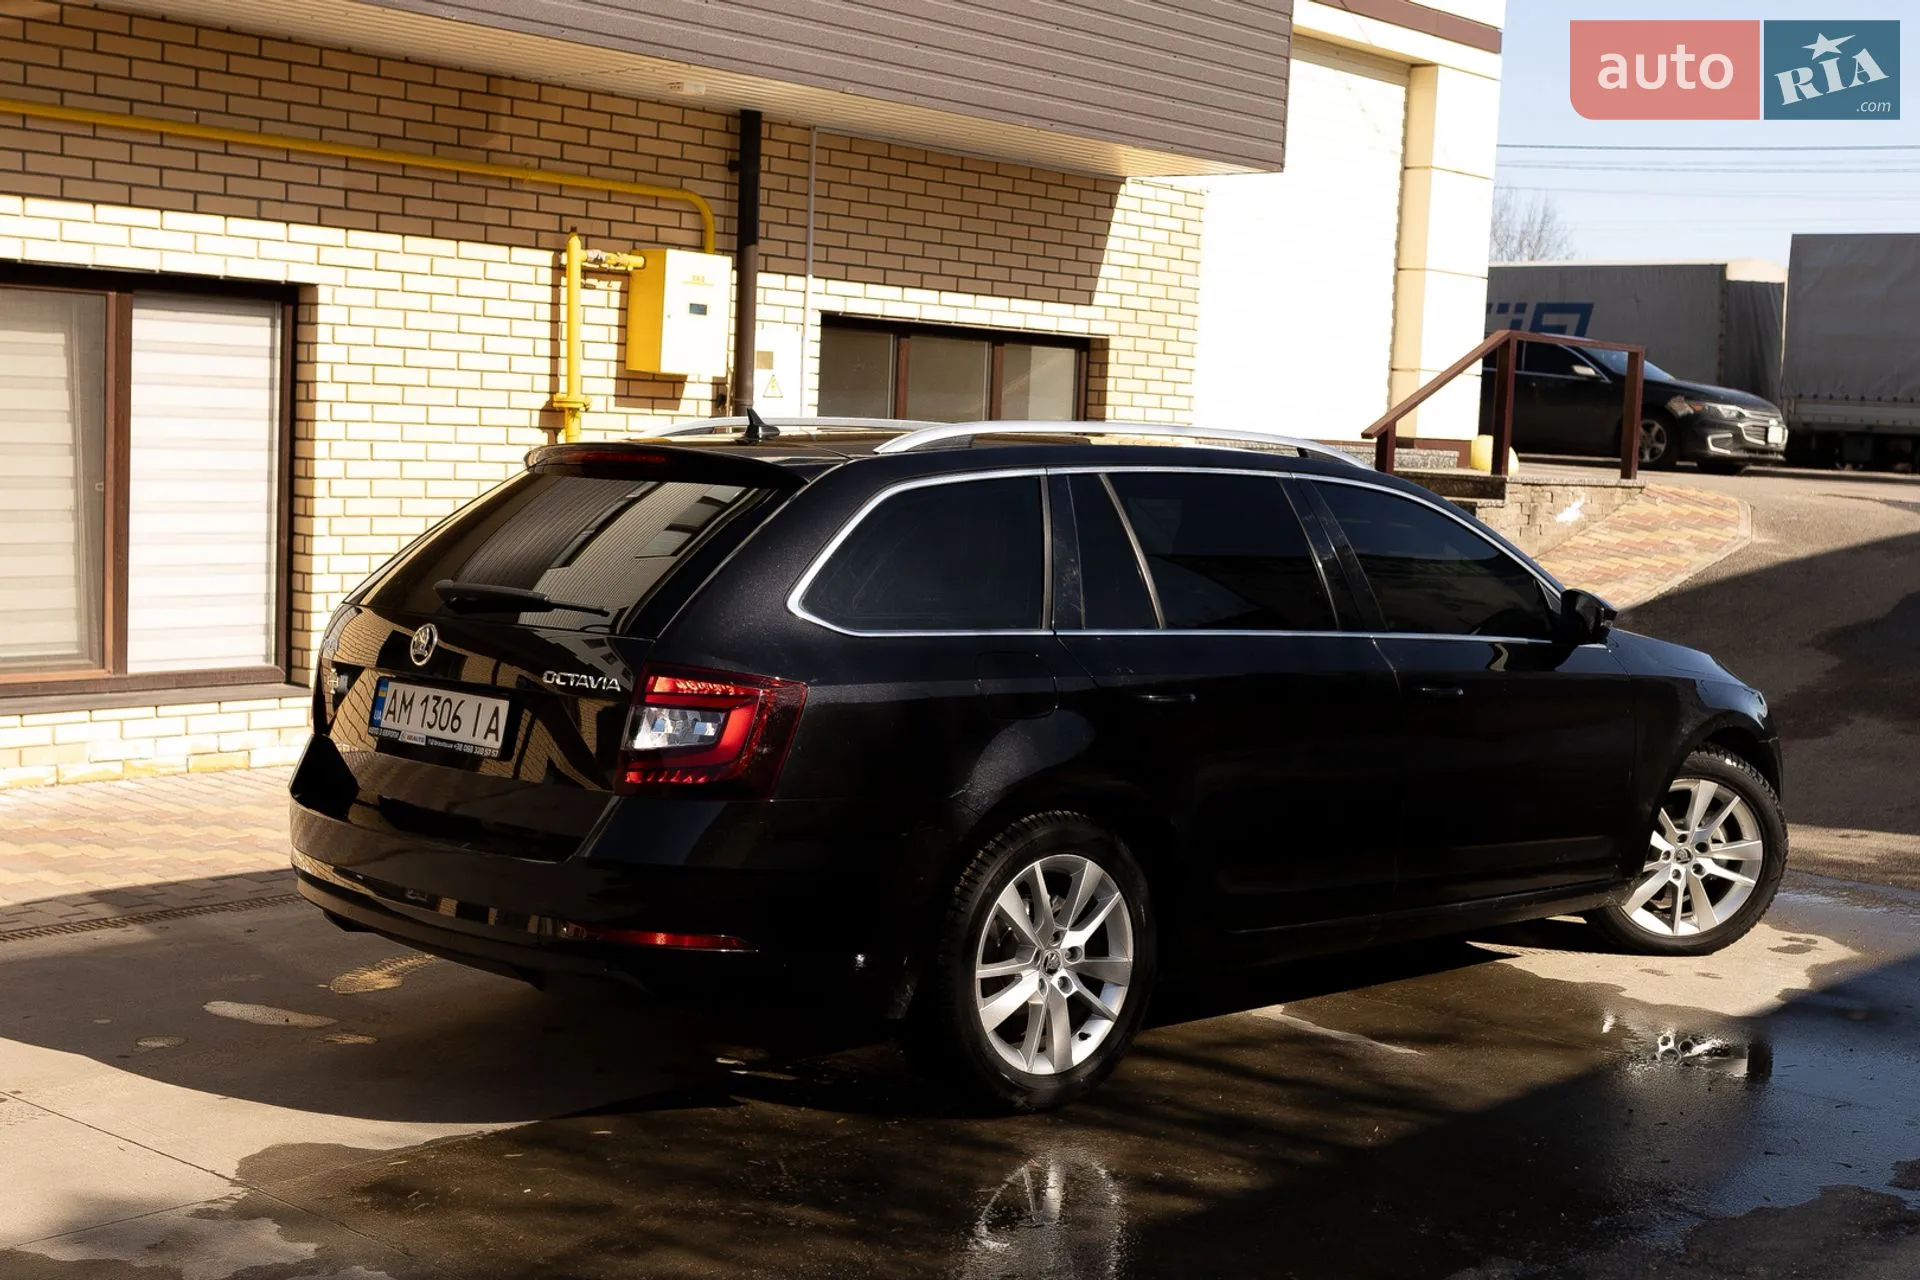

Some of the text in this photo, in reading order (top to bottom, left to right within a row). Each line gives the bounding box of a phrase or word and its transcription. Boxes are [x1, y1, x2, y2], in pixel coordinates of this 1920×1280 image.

[542, 670, 621, 692] OCTAVIA
[384, 688, 416, 725] AM
[420, 694, 465, 734] 1306
